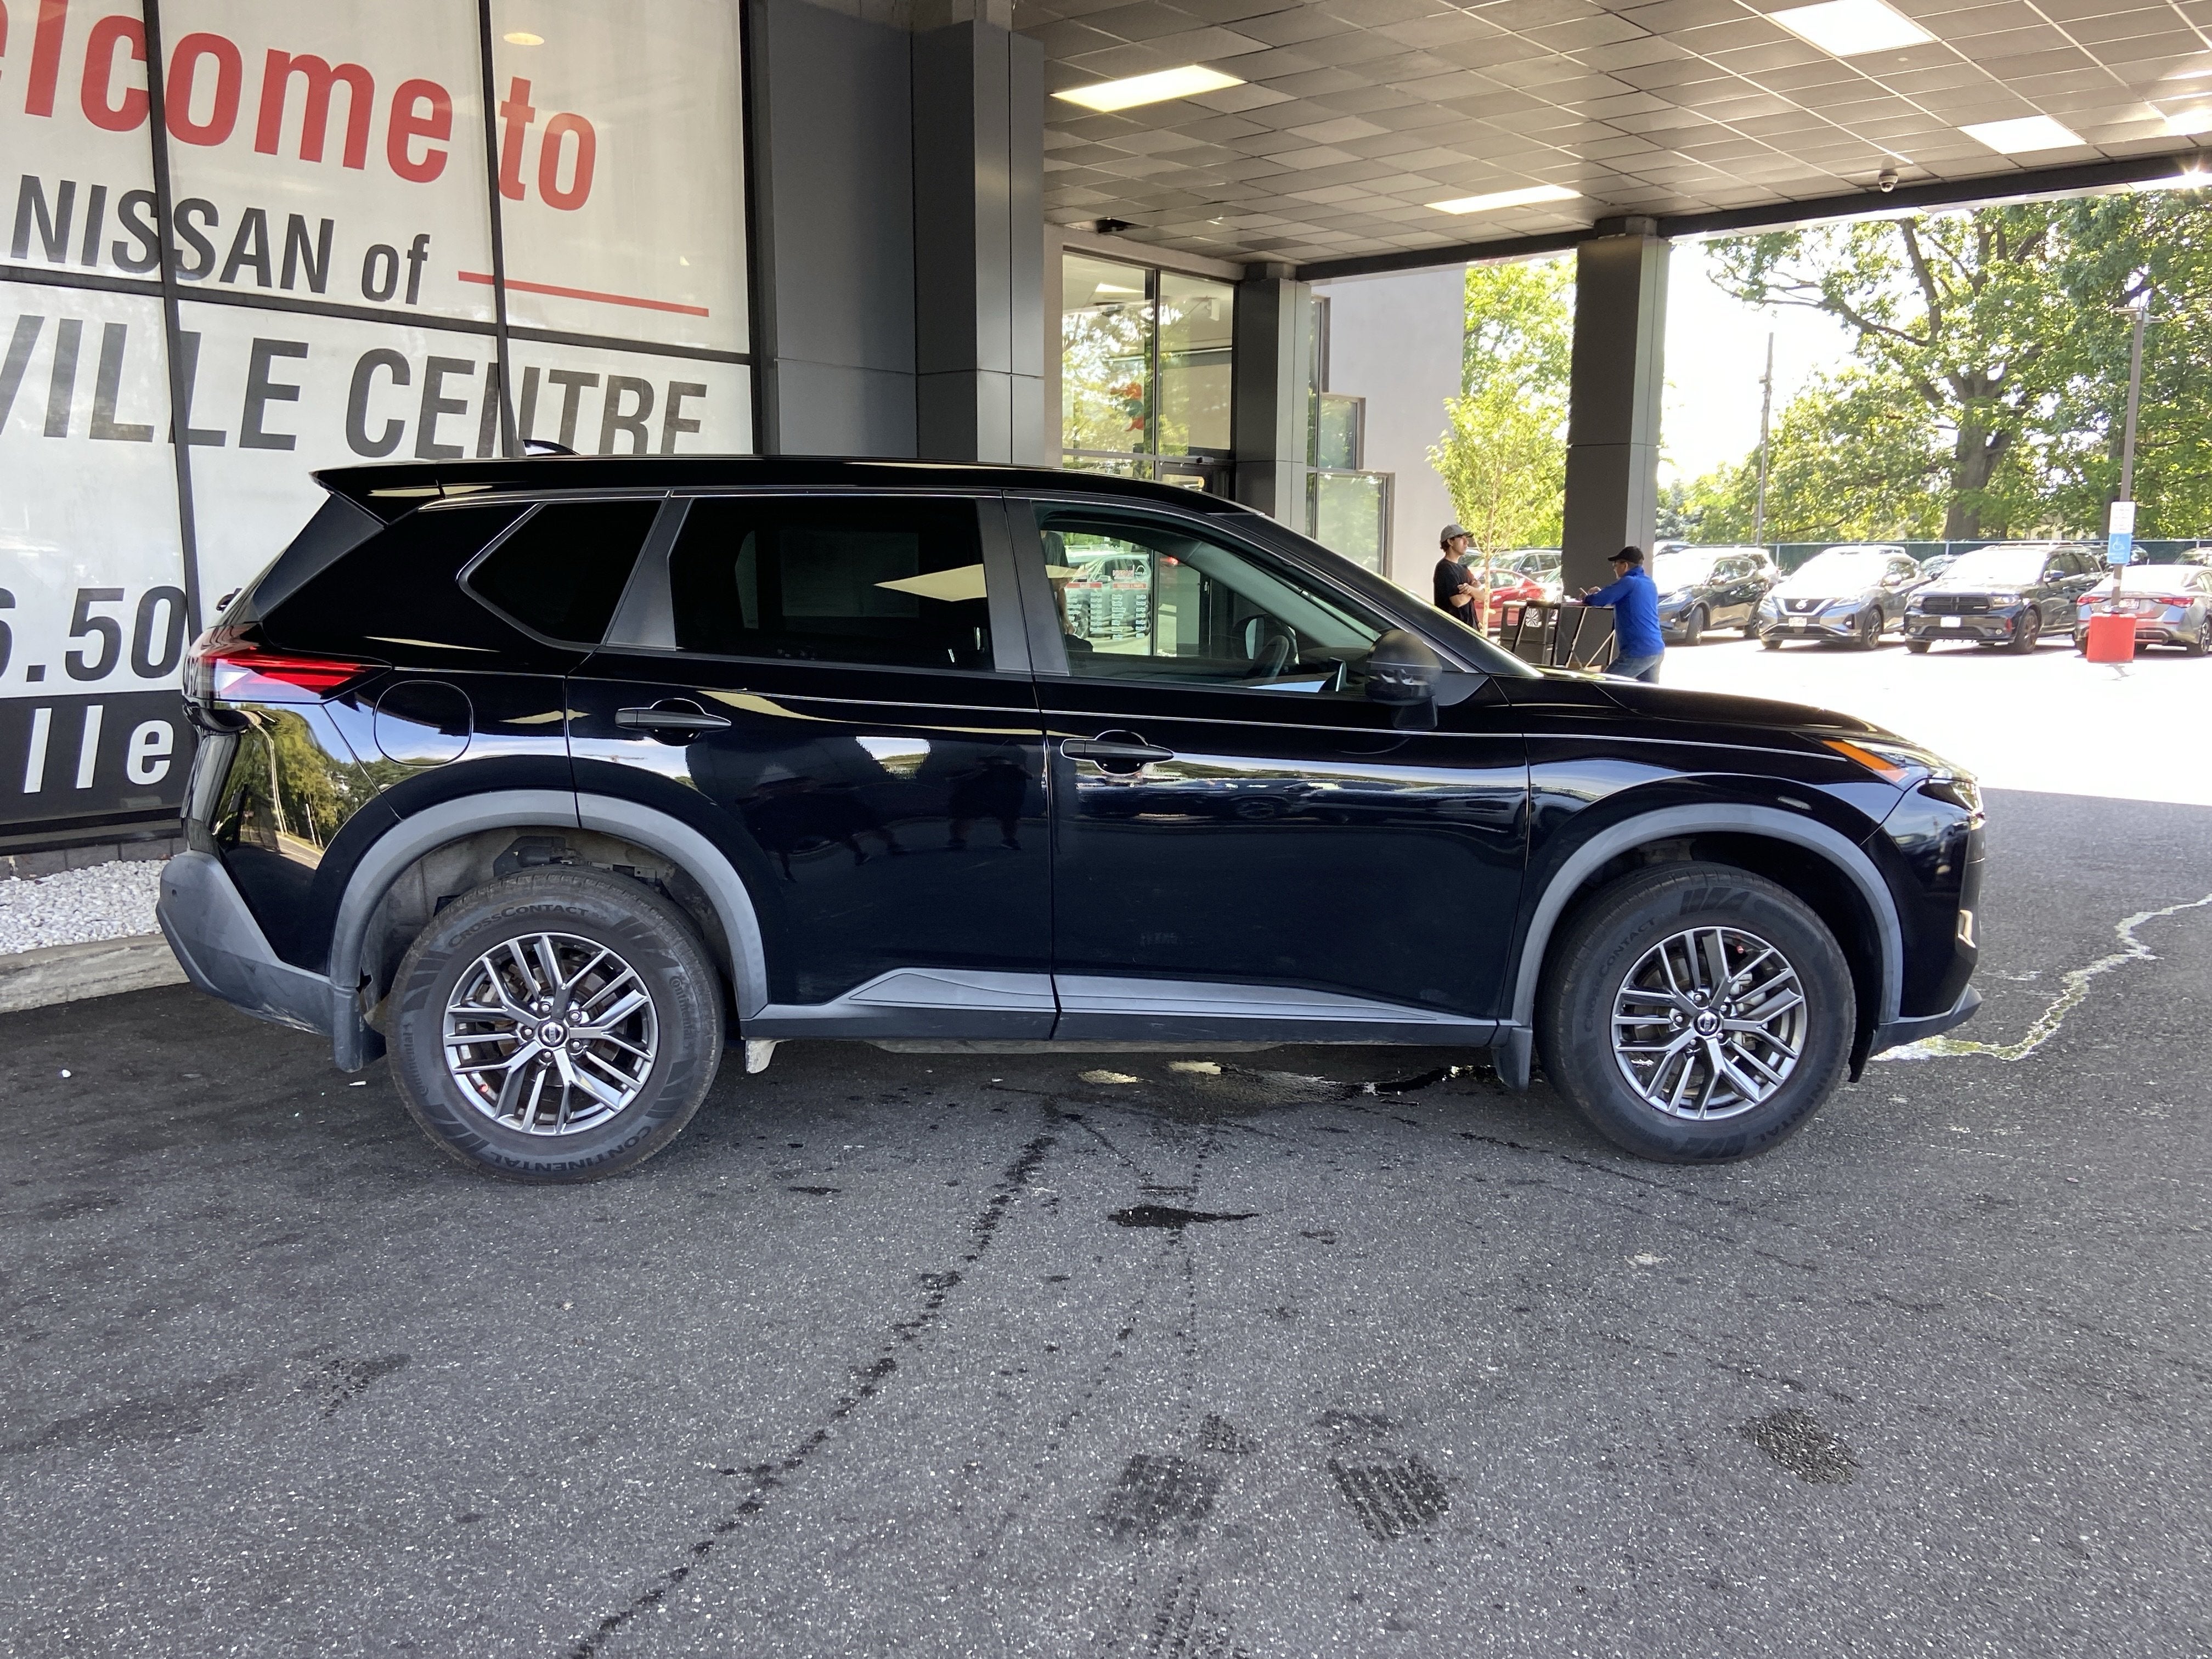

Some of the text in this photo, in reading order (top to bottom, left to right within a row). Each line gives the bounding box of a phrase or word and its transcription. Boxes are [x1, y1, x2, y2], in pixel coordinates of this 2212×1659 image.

[0, 0, 597, 211] lcome to
[10, 174, 430, 306] NISSAN of
[345, 348, 708, 459] CENTRE
[490, 1126, 652, 1172] CONTINENTAL
